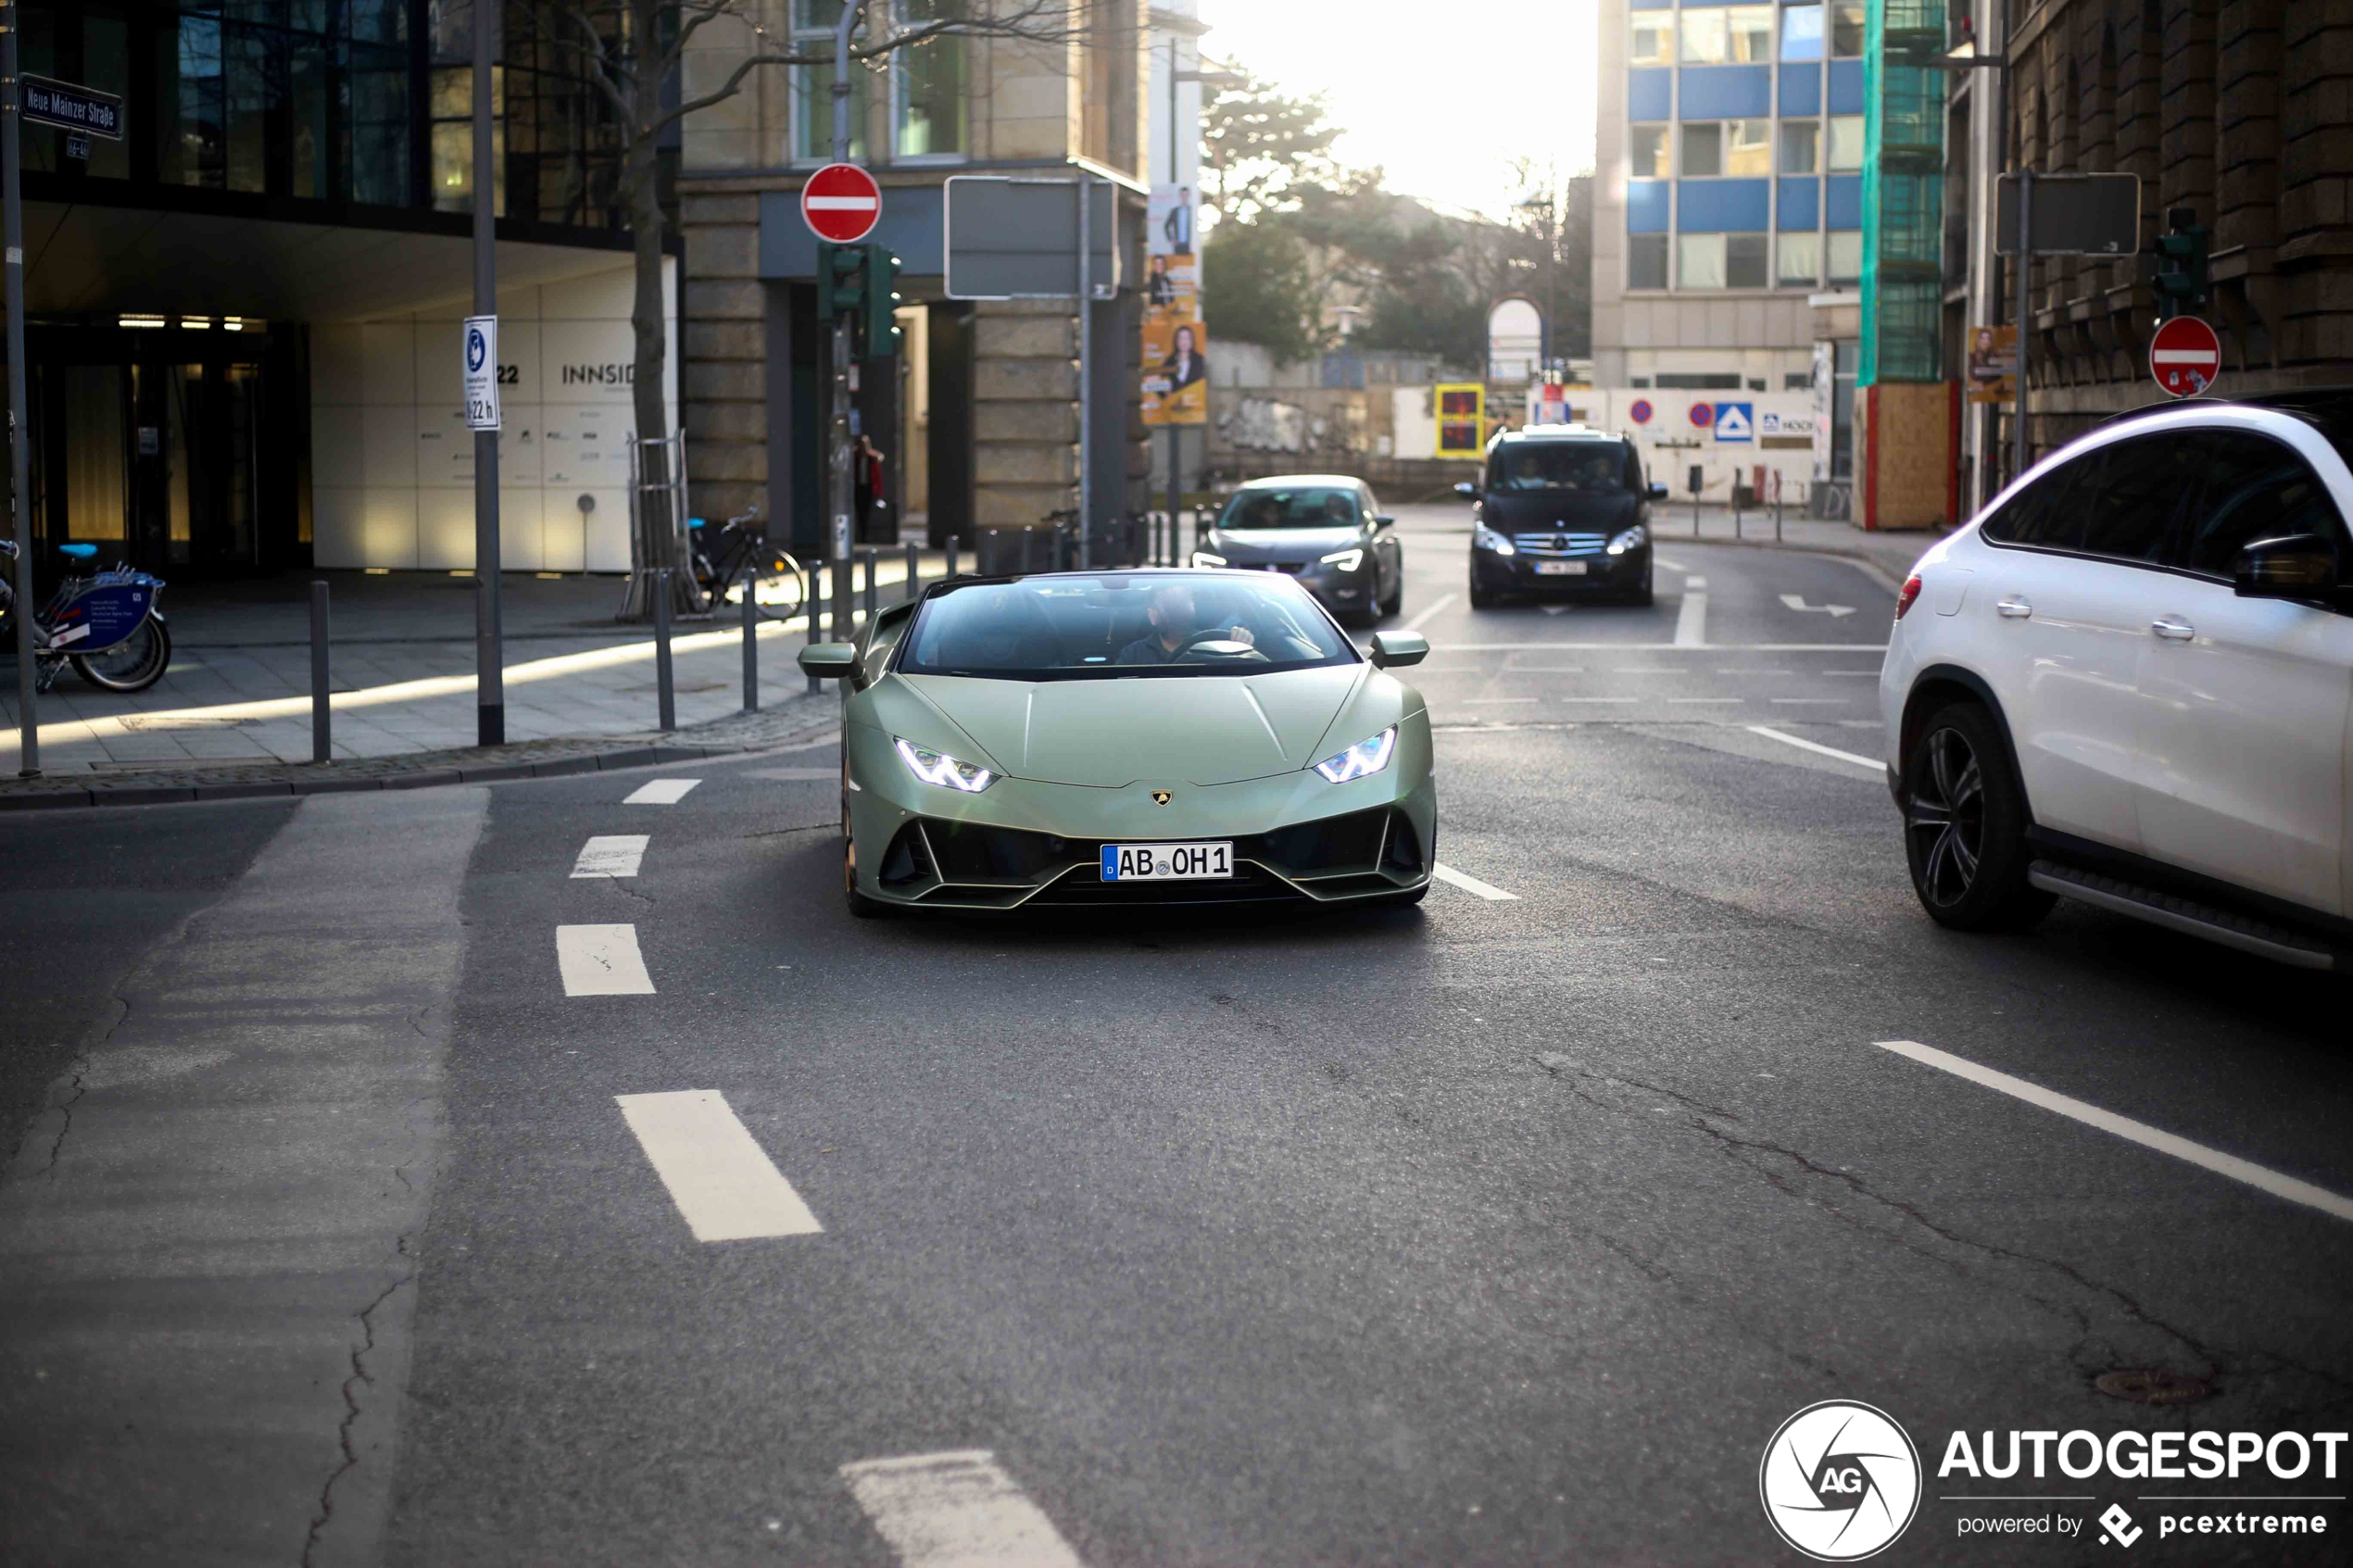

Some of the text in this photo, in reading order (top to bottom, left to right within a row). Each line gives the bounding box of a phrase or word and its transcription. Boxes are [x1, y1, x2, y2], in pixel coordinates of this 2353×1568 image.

[28, 88, 114, 128] Neue Mainzer Straße
[1119, 849, 1153, 876] AB
